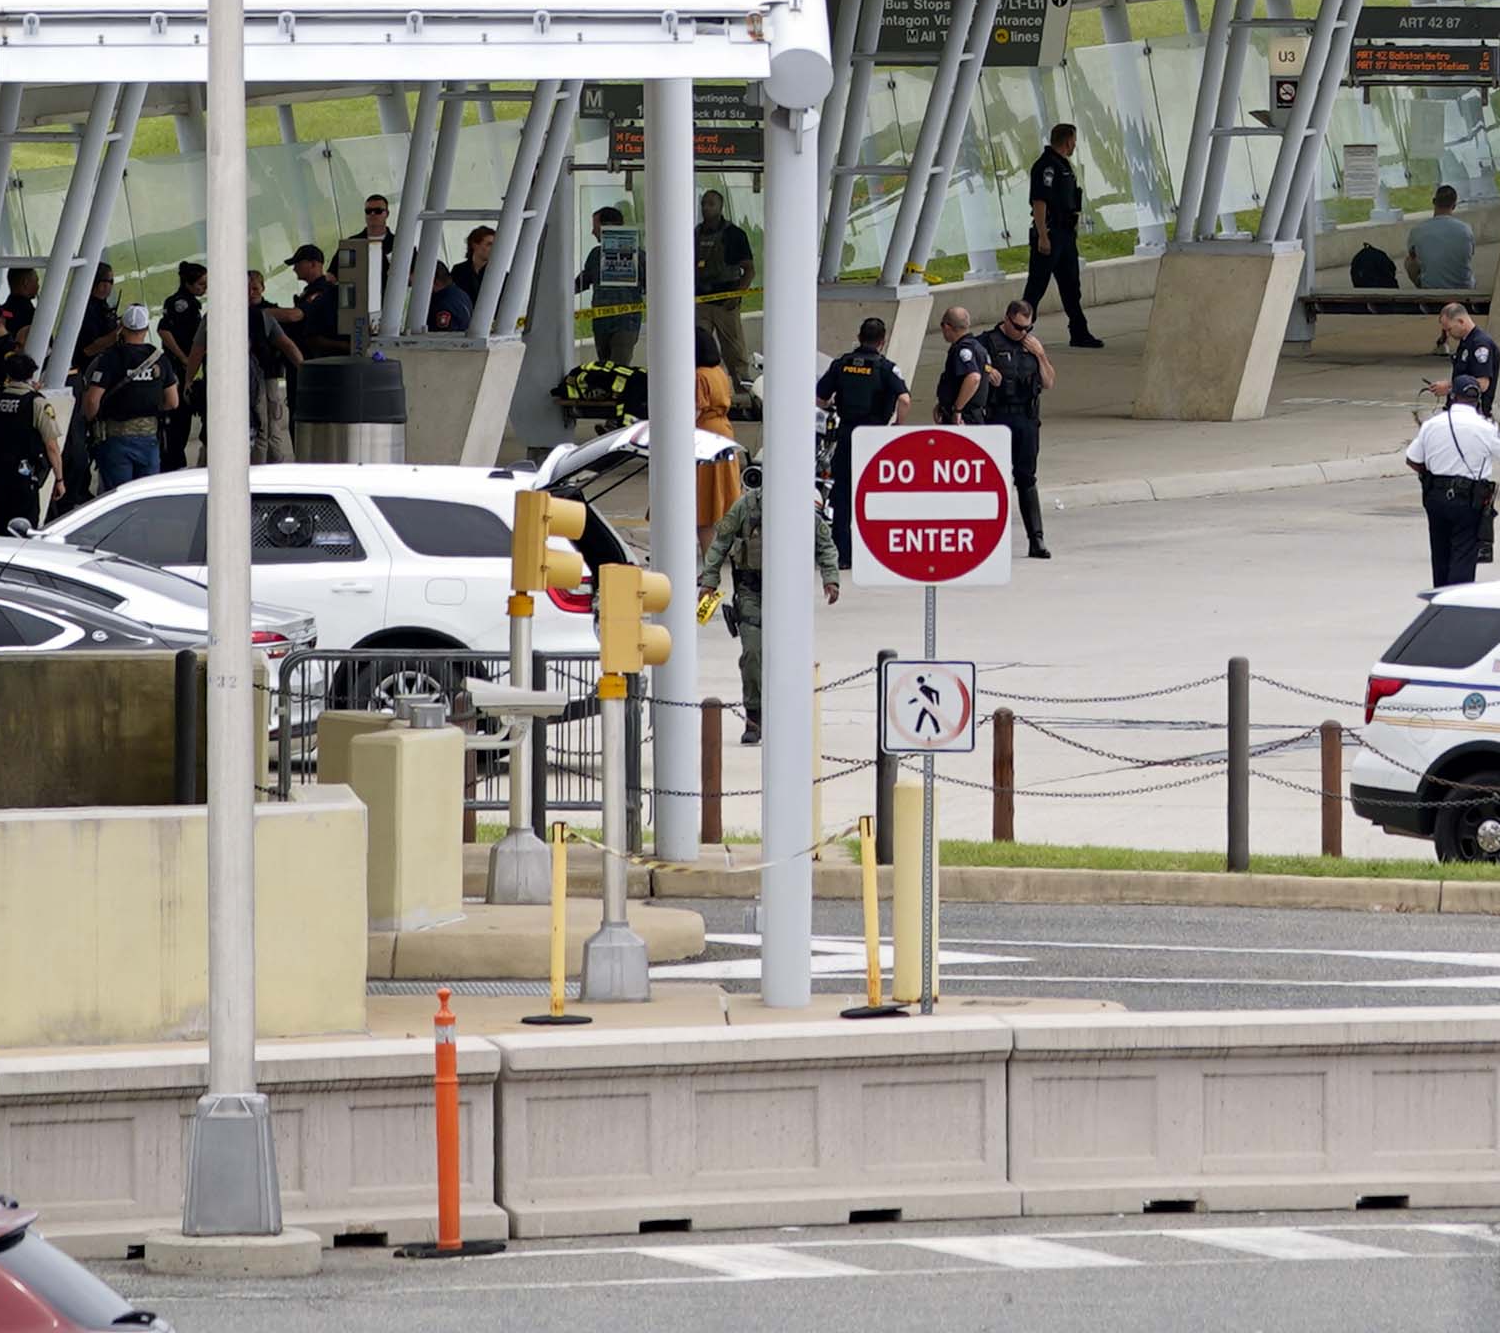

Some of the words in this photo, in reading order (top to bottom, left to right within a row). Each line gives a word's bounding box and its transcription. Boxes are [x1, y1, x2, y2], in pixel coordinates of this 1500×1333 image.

[885, 0, 908, 10] Bus
[995, 15, 1042, 27] ntrance
[1399, 17, 1424, 29] ART
[1428, 17, 1443, 29] 42
[1446, 17, 1461, 28] 87
[920, 30, 936, 42] All
[1010, 30, 1040, 42] lines
[1278, 51, 1296, 63] U3
[694, 94, 739, 105] untington
[729, 109, 746, 119] Sta
[843, 365, 872, 375] POLICE
[878, 459, 915, 484] DO
[933, 458, 986, 483] NOT
[888, 528, 975, 553] ENTER
